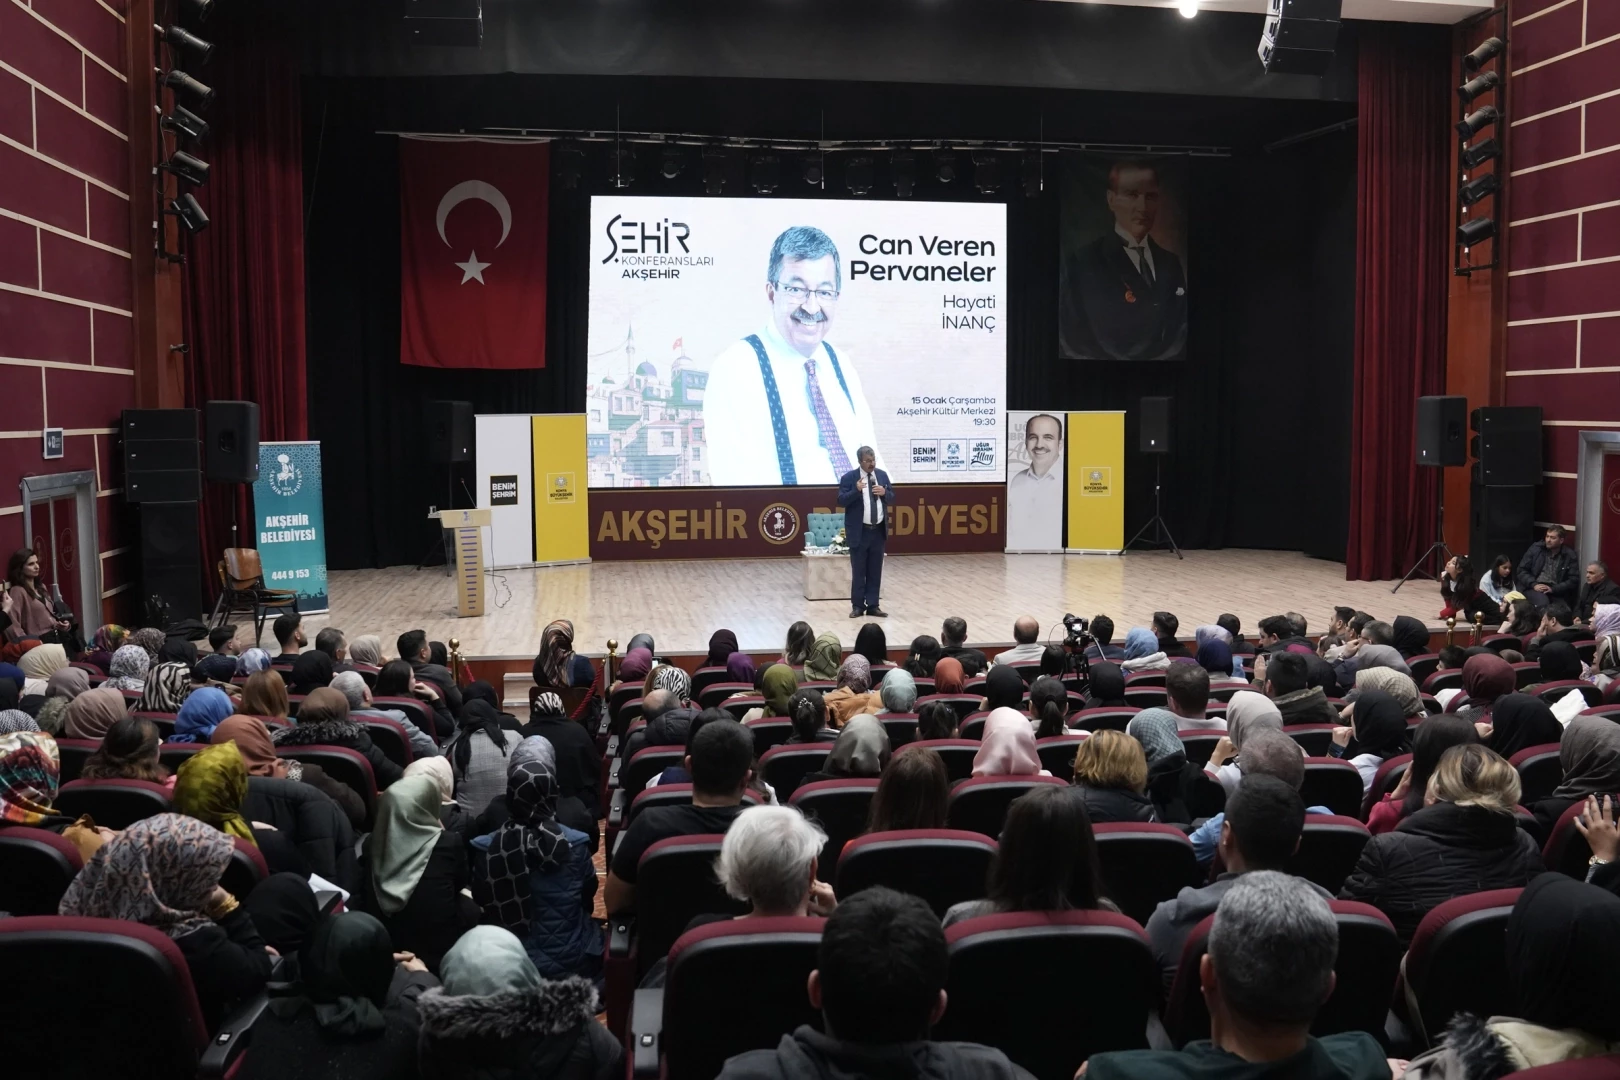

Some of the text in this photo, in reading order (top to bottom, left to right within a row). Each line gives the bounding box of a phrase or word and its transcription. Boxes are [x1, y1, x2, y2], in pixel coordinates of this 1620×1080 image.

[602, 214, 690, 264] ŞEHİR
[859, 234, 995, 256] Can Veren
[621, 256, 714, 266] KONFERANSLARI
[621, 267, 680, 281] AKŞEHİR
[850, 260, 996, 282] Pervaneler
[943, 295, 996, 312] Hayati
[942, 313, 996, 333] İNANÇ
[911, 396, 996, 406] 15 Ocak Çarşamba
[897, 406, 996, 417] Akşehir Kültür Merkezi
[973, 418, 996, 426] 19:30
[265, 513, 309, 529] AKŞEHİR
[597, 496, 998, 549] AKŞEHİR DİYESİ
[260, 527, 316, 543] BELEDİYESİ
[271, 569, 310, 580] 444 9 153
